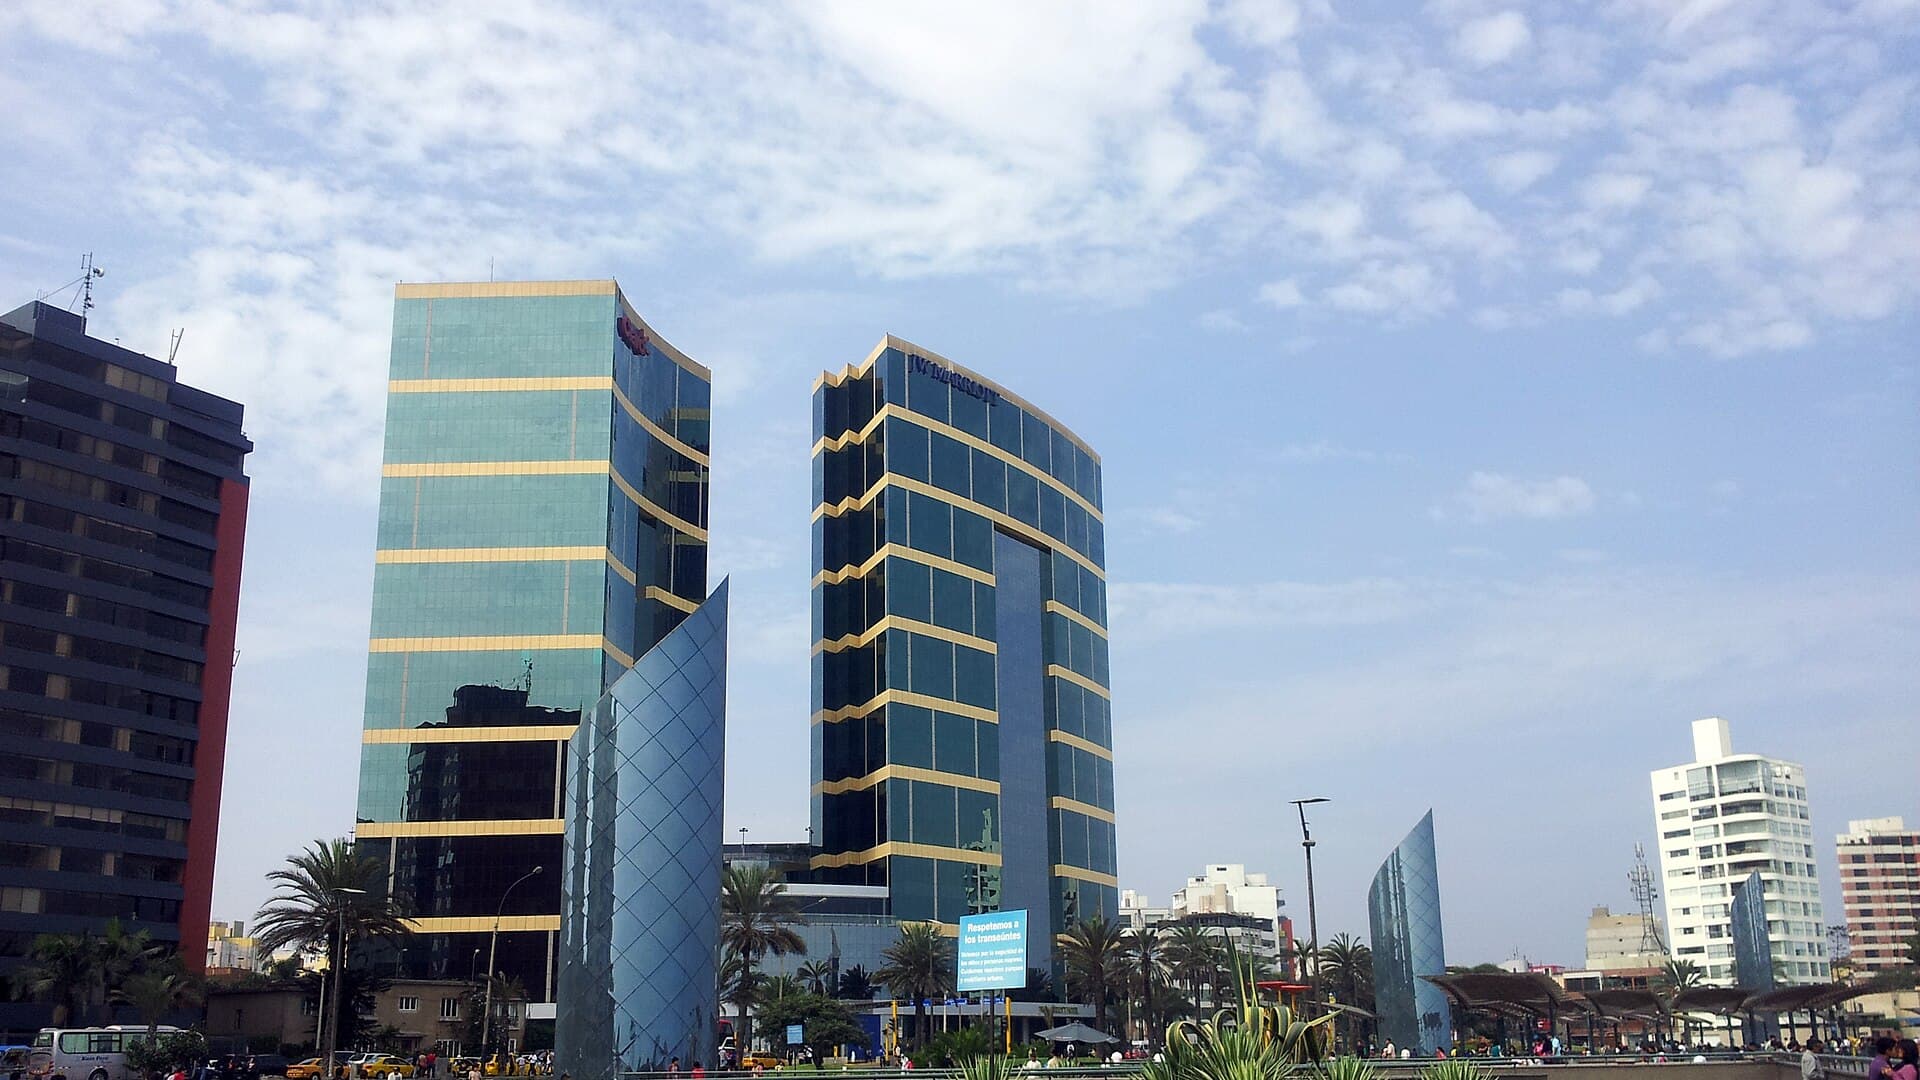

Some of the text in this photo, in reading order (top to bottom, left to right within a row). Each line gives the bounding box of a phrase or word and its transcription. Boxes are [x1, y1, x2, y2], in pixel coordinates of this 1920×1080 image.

[908, 354, 930, 375] JW
[967, 921, 1012, 932] Respetemos
[964, 931, 1021, 944] los transeúntes
